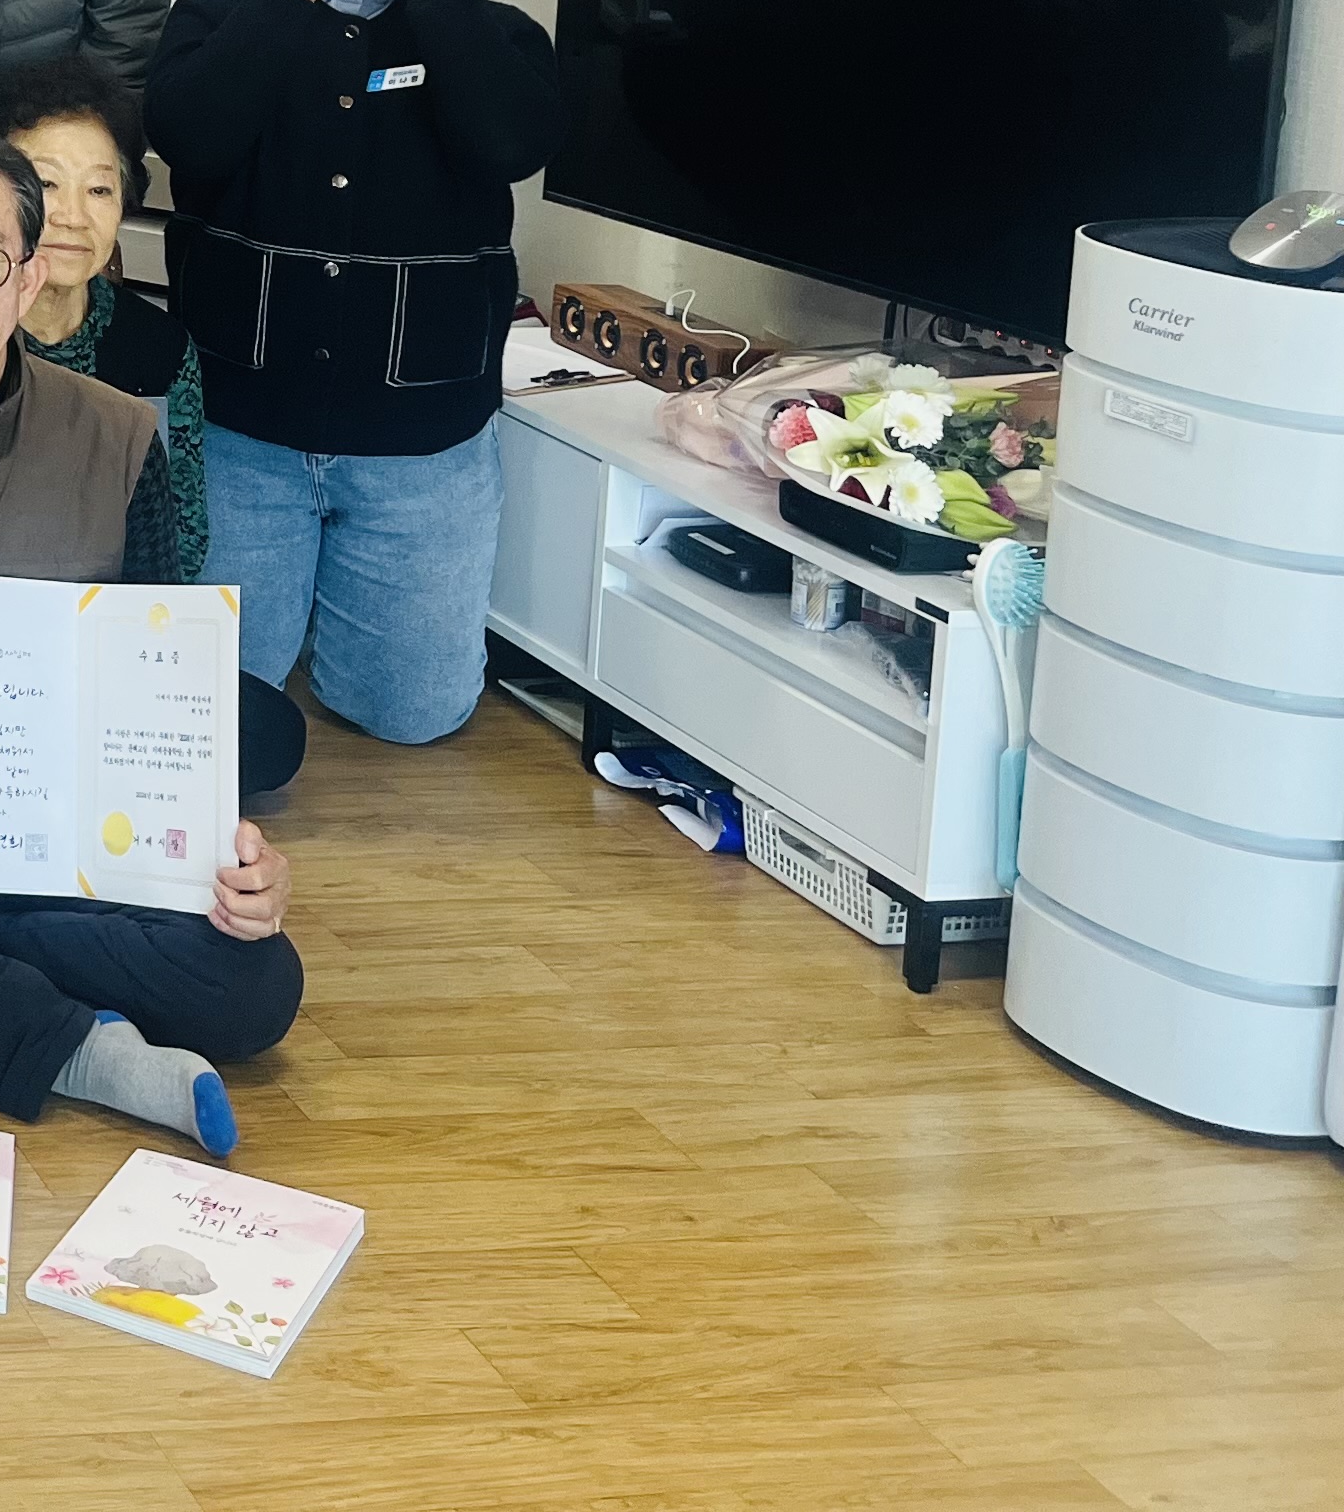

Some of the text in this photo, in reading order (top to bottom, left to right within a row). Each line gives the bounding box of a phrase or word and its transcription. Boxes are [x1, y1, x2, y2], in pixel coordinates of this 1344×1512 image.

[1128, 297, 1194, 328] Carrier
[171, 1192, 243, 1217] 세월에
[189, 1212, 225, 1231] 지지
[235, 1221, 279, 1240] 않고
